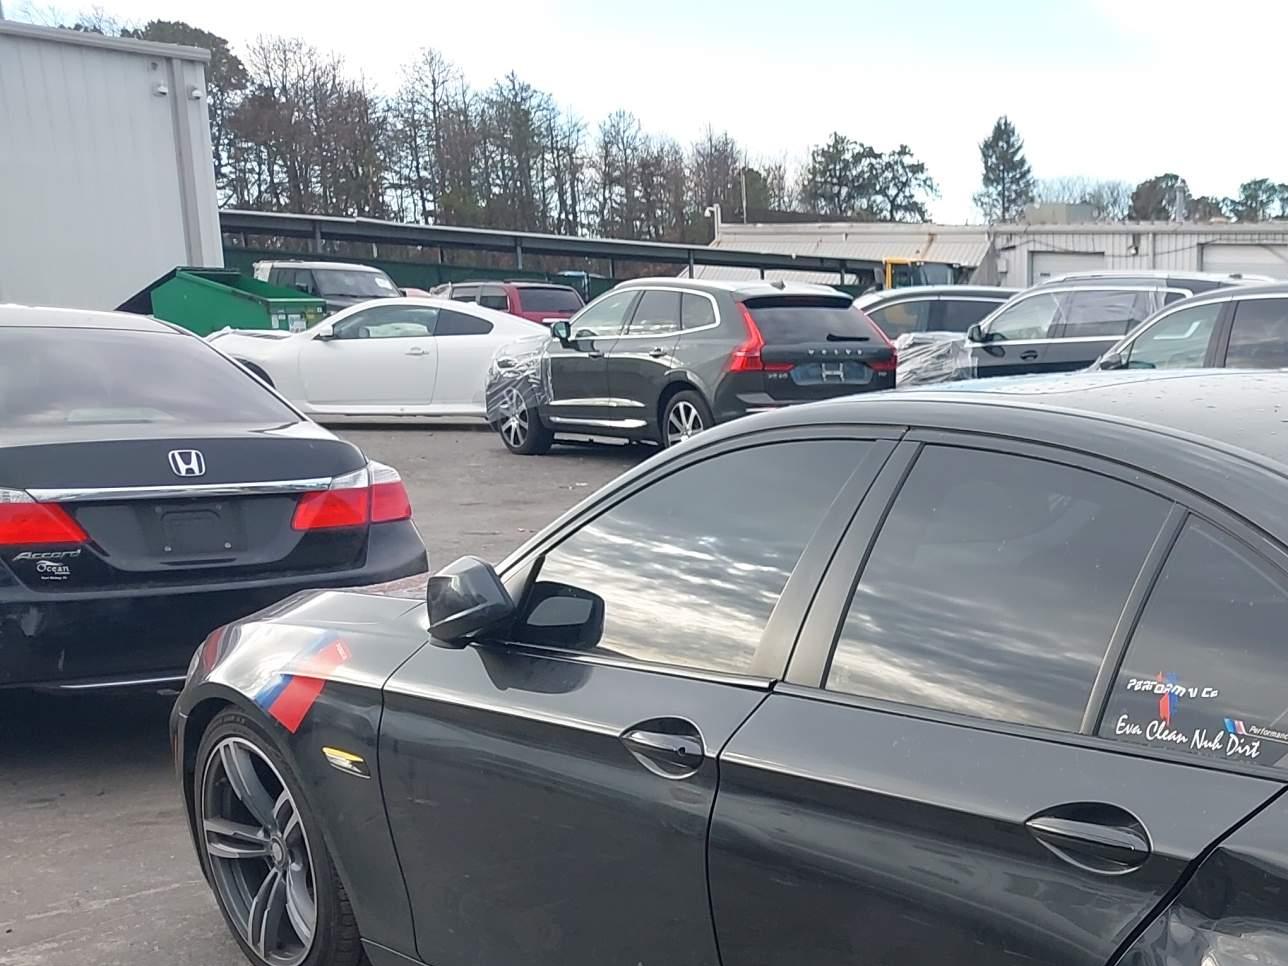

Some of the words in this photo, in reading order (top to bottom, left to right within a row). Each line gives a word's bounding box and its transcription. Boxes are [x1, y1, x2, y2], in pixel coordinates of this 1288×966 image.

[12, 549, 81, 561] Accord
[1115, 713, 1143, 736] Eva
[1145, 719, 1189, 745] Clean
[1225, 733, 1262, 759] Dirt
